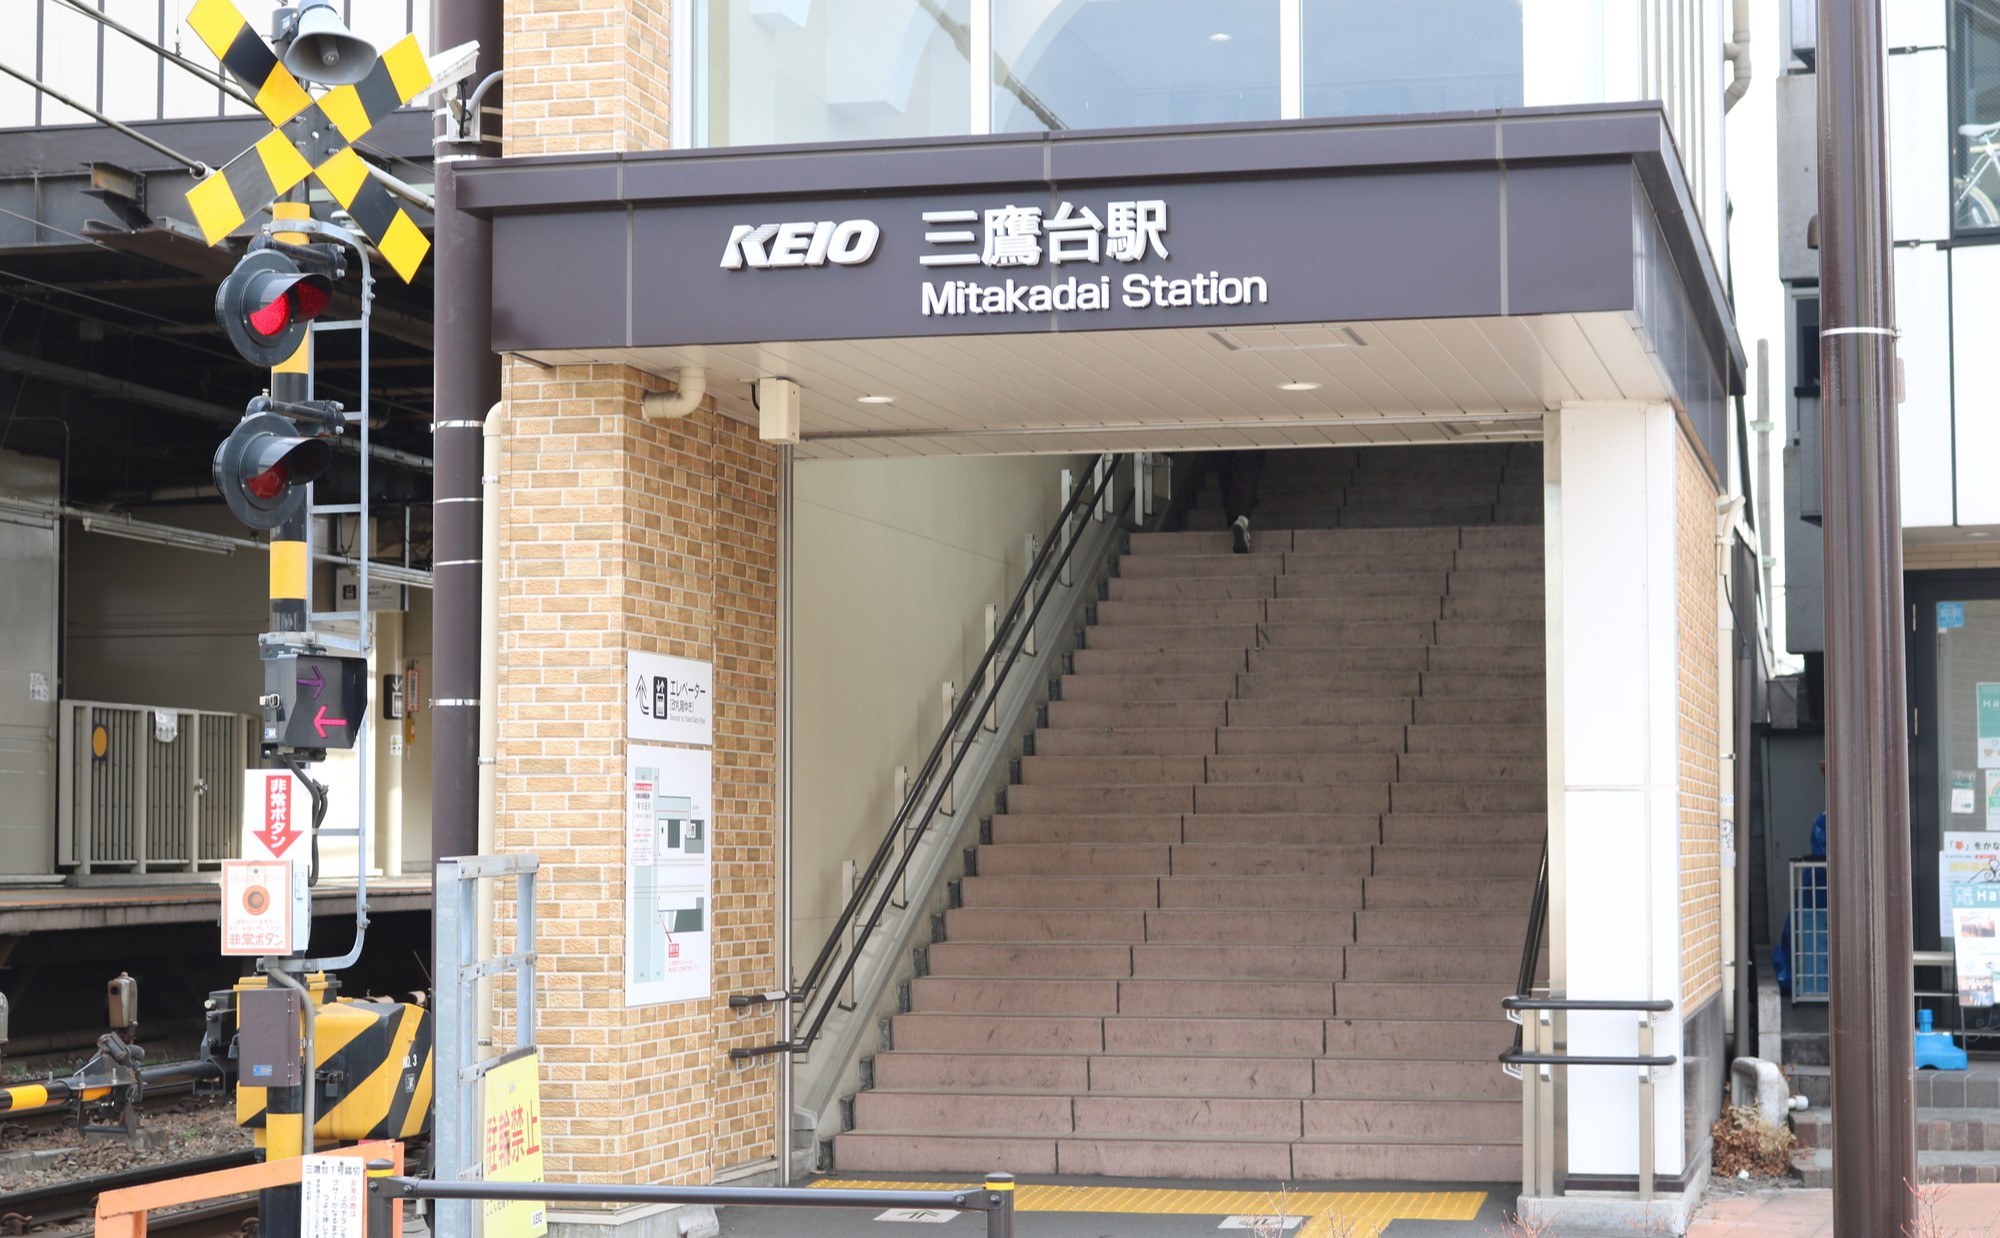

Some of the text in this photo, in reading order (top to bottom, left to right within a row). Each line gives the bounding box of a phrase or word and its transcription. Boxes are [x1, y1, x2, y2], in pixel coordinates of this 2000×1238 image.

[719, 218, 881, 270] KEIO
[919, 199, 1169, 268] 三鷹台駅
[920, 270, 1269, 317] Mitakadai Station
[670, 680, 705, 699] エレベーター
[270, 778, 287, 848] 非常ボタン
[228, 932, 284, 946] 非常ボタン
[486, 1099, 540, 1176] 駐輪禁止
